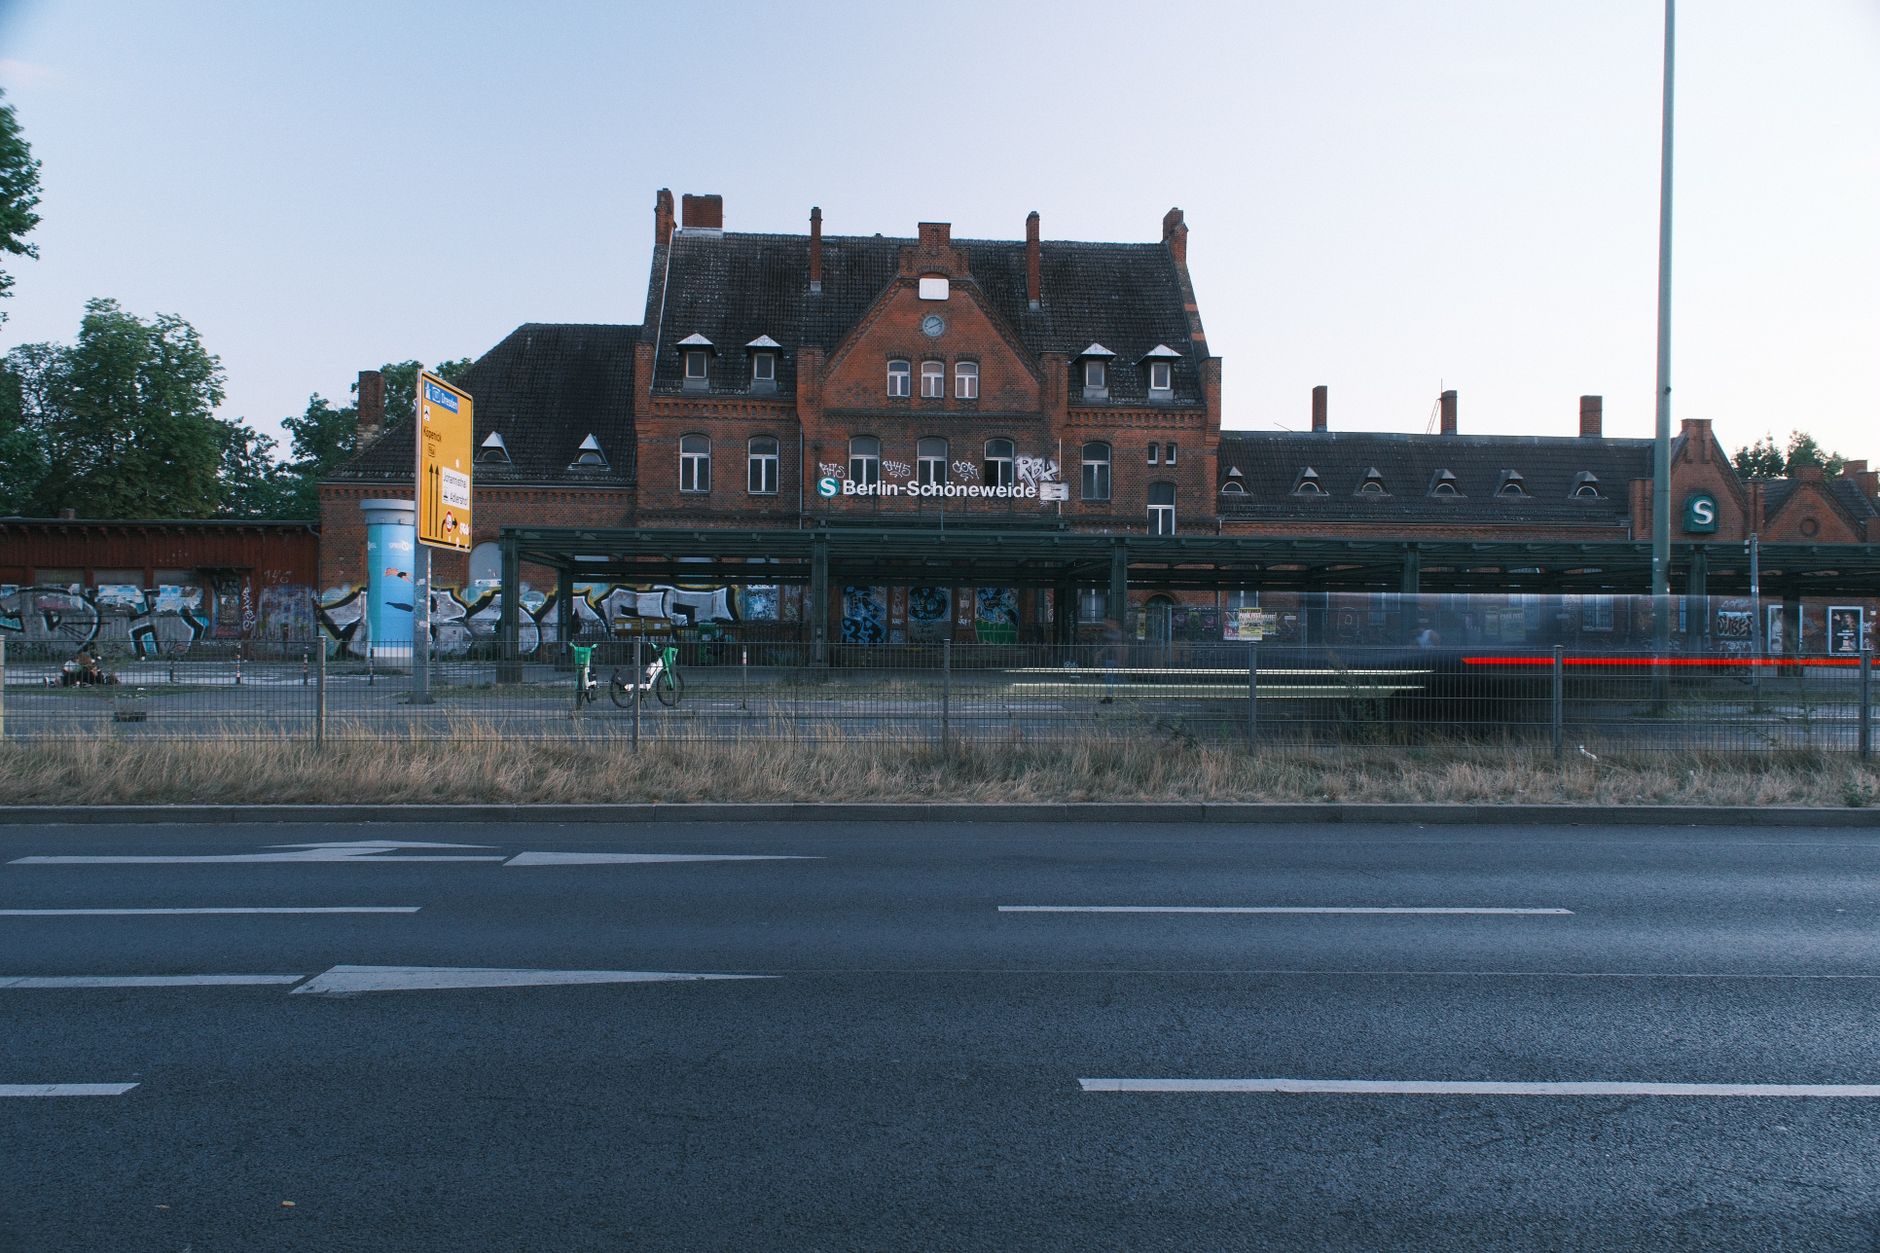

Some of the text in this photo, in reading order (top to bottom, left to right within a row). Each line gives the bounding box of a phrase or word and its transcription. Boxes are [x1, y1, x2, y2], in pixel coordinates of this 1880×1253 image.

[819, 477, 1037, 498] S Berlin-Schöneweide
[1692, 499, 1714, 525] S
